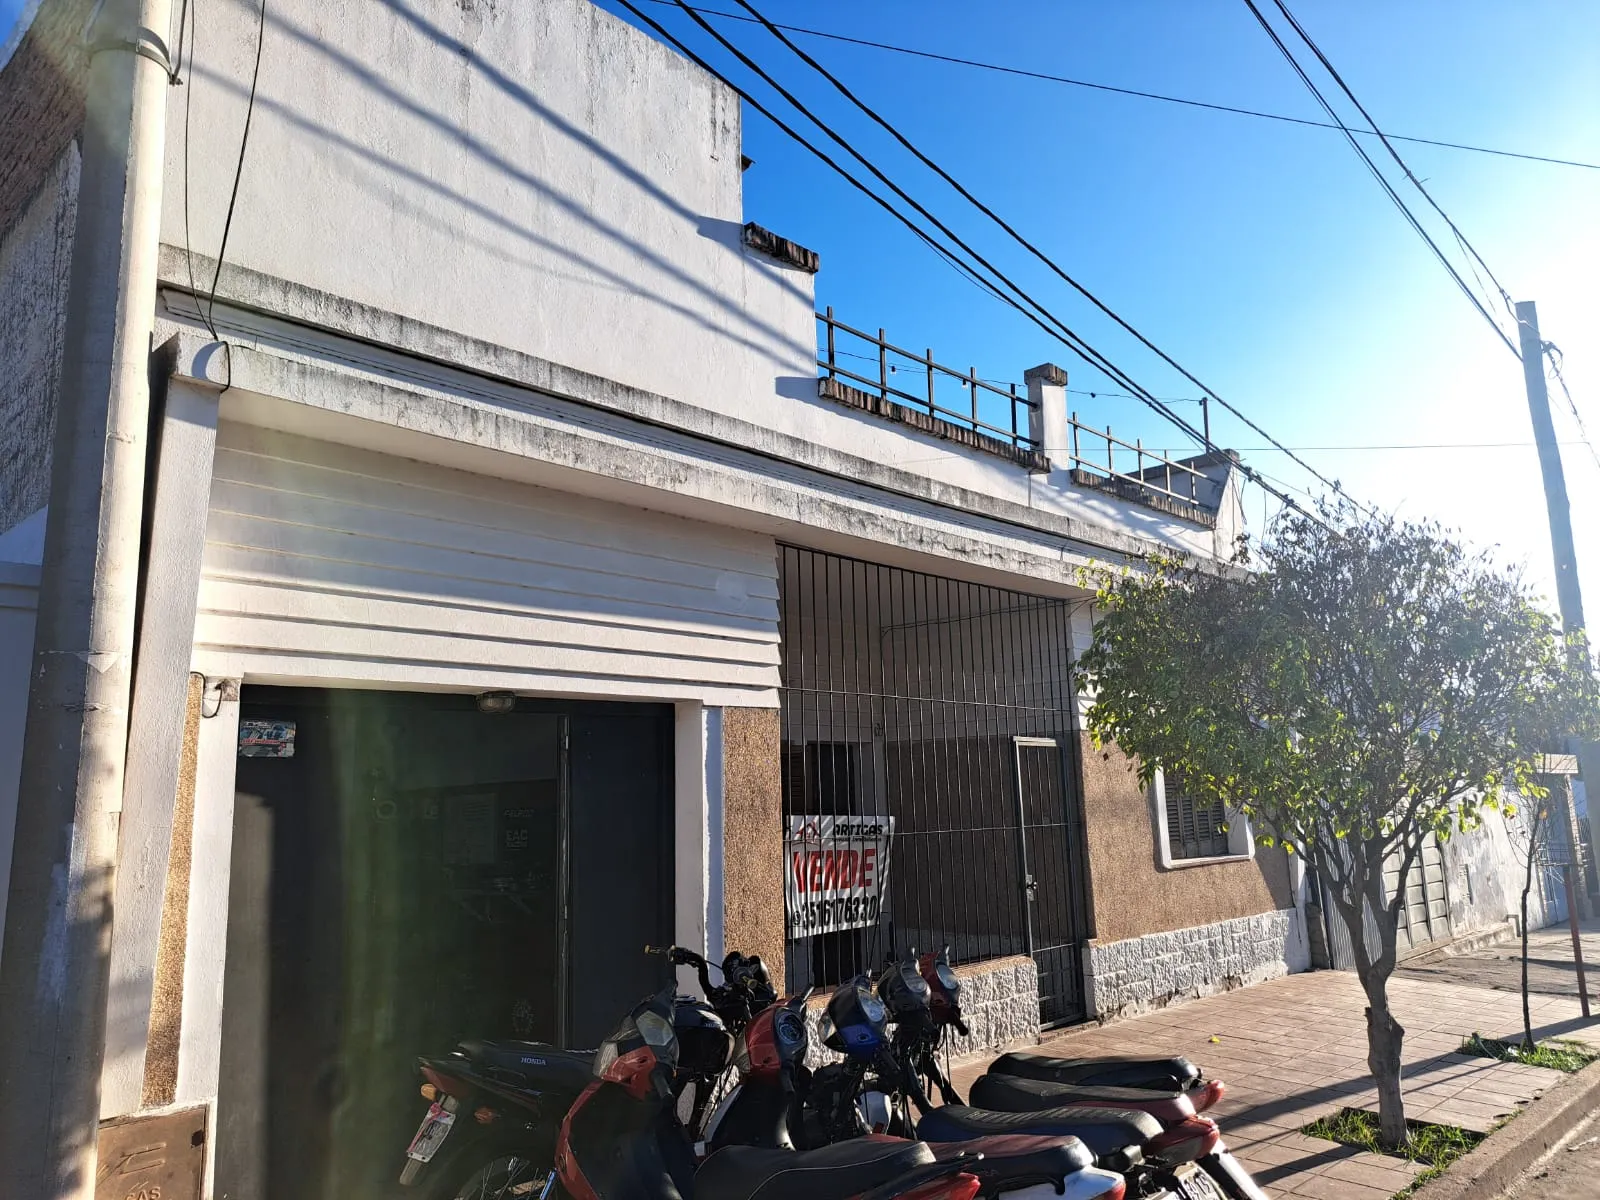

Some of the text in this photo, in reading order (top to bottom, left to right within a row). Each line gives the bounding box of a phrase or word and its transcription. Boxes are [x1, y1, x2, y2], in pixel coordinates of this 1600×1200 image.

[833, 824, 883, 836] ARTIGAS
[793, 848, 876, 893] VENDE
[521, 1057, 546, 1065] HONDA
